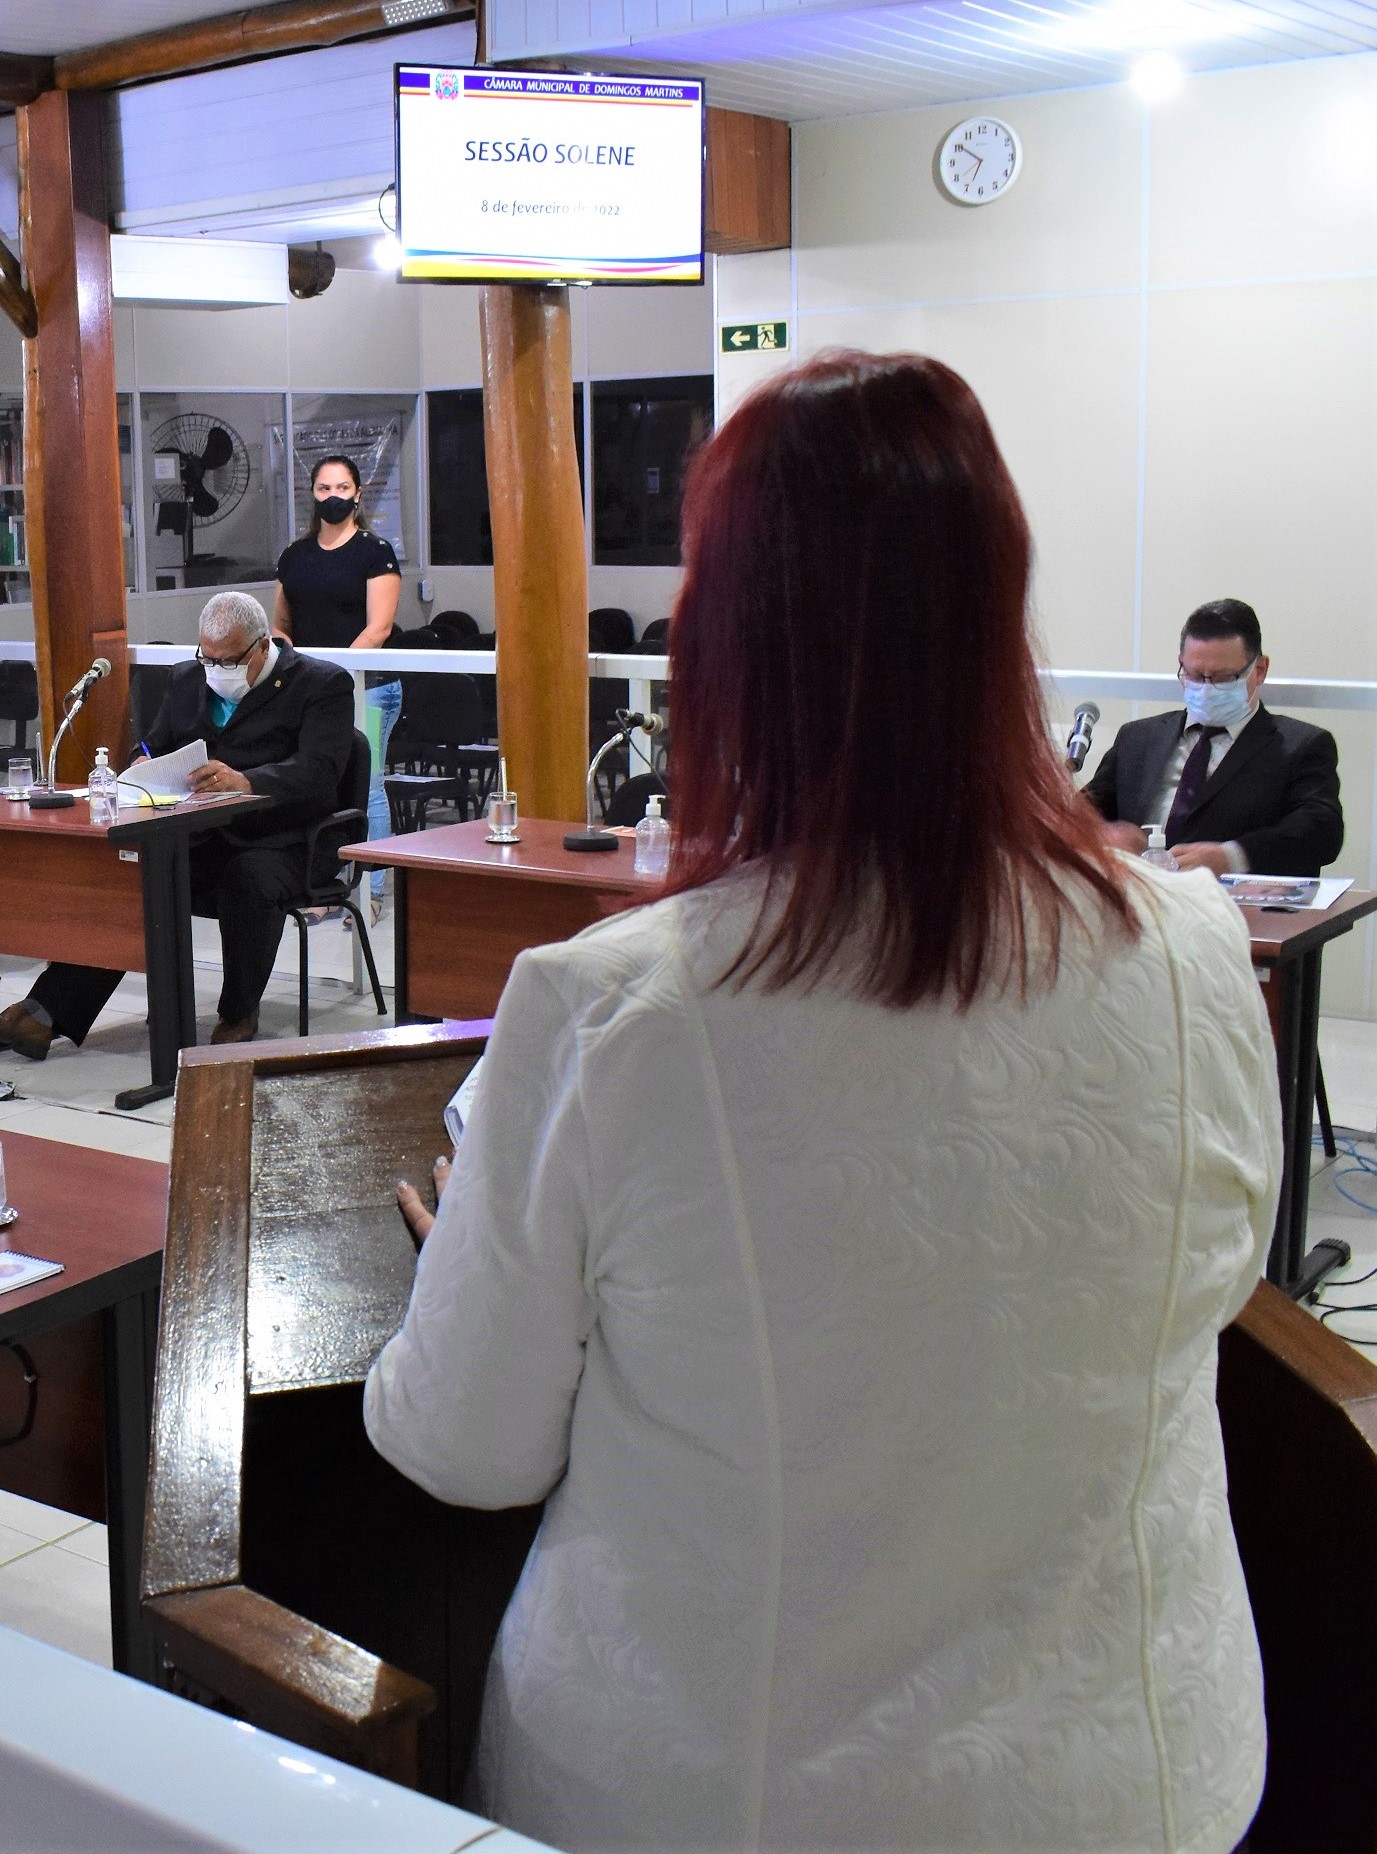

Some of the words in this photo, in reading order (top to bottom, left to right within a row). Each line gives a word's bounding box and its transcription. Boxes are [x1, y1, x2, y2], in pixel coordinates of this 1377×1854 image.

[484, 77, 523, 90] CÂMARA
[526, 81, 575, 93] MUNICIPAL
[578, 83, 591, 94] DE
[594, 84, 641, 96] DOMINGOS
[644, 86, 684, 98] MARTINS
[978, 126, 987, 134] 12
[994, 128, 998, 136] 1
[964, 132, 972, 140] 11
[465, 137, 548, 163] SESSÃO
[554, 144, 636, 166] SOLENE
[950, 160, 956, 168] 9
[1003, 169, 1008, 178] 4
[964, 184, 970, 192] 7
[992, 182, 998, 190] 5
[978, 187, 984, 196] 6
[481, 200, 489, 213] 8
[492, 199, 509, 213] de
[511, 200, 570, 217] fevereiro
